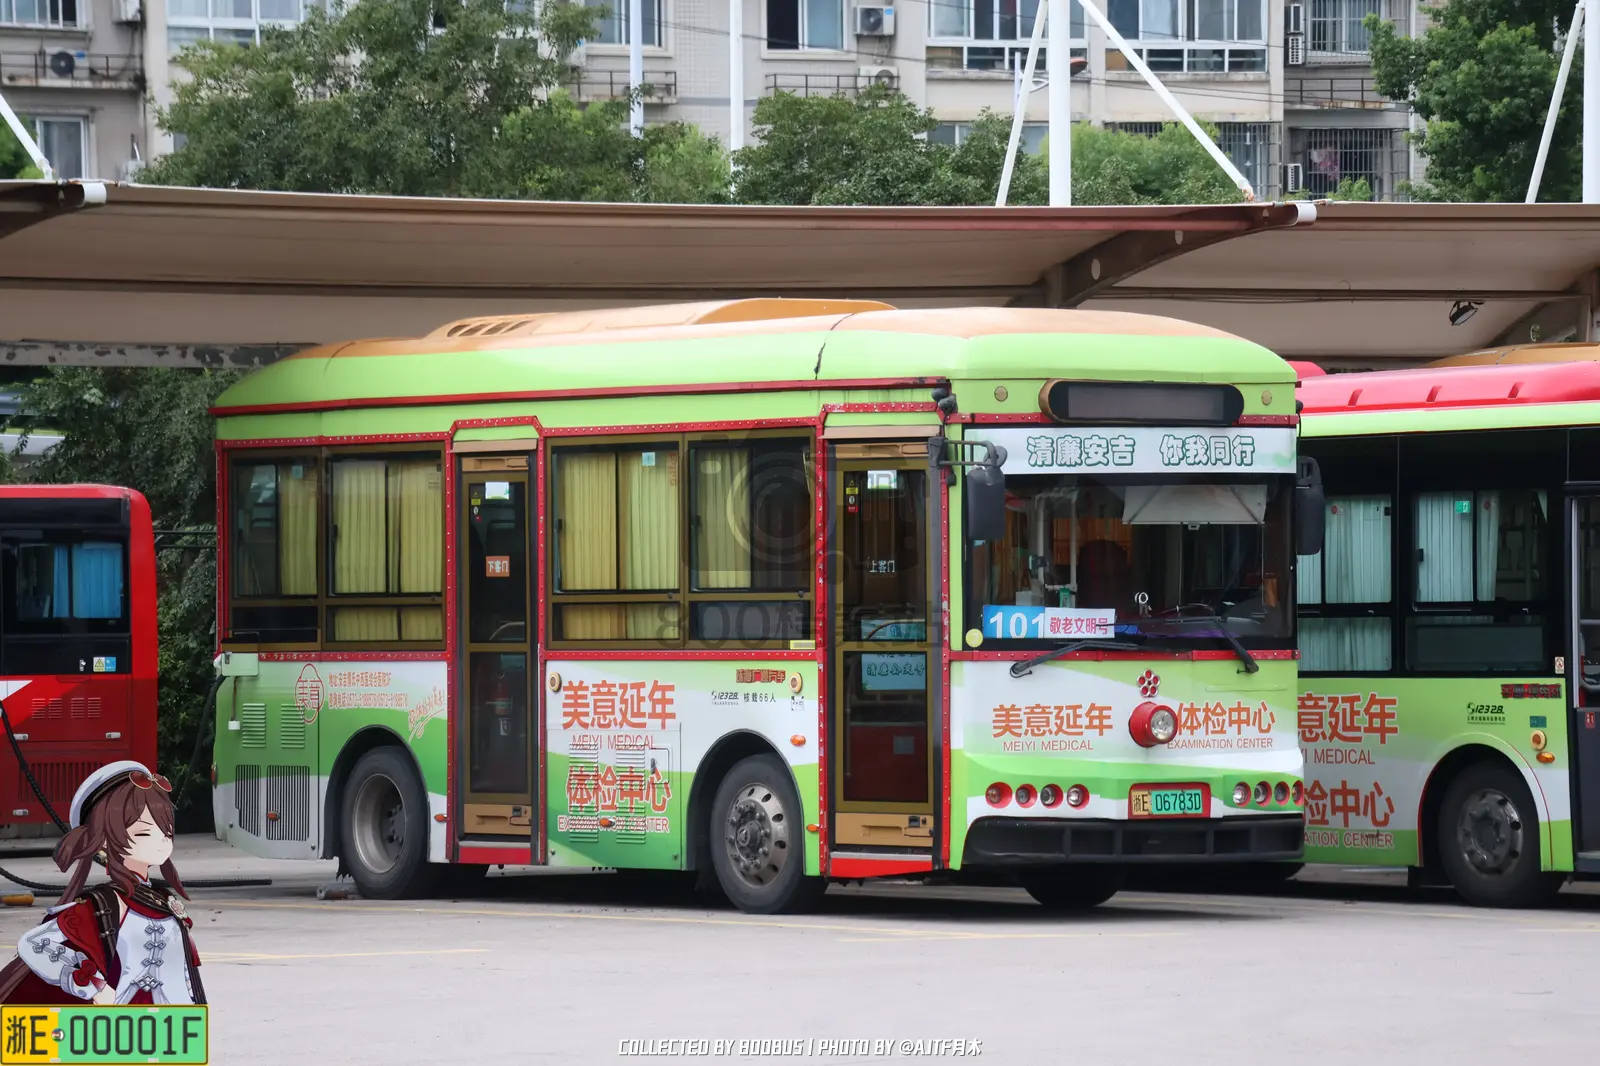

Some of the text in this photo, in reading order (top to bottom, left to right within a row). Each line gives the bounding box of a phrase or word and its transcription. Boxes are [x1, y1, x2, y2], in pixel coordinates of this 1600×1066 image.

[1026, 434, 1255, 467] 清廉安吉 你我同行
[487, 560, 509, 573] 下客门
[989, 611, 1045, 638] 101
[1049, 616, 1109, 635] 敬老文明号
[562, 679, 677, 730] 美意延年
[992, 702, 1114, 739] 美意延年
[1177, 700, 1276, 736] 体检中心
[572, 734, 655, 751] MEIYI MEDICAL
[1003, 739, 1094, 752] MEIYI MEDICAL
[1167, 738, 1273, 750] EXAMINATION CENTER
[1313, 748, 1375, 765] MEDICAL
[567, 765, 672, 813] 体检中心
[1343, 831, 1394, 848] CENTER
